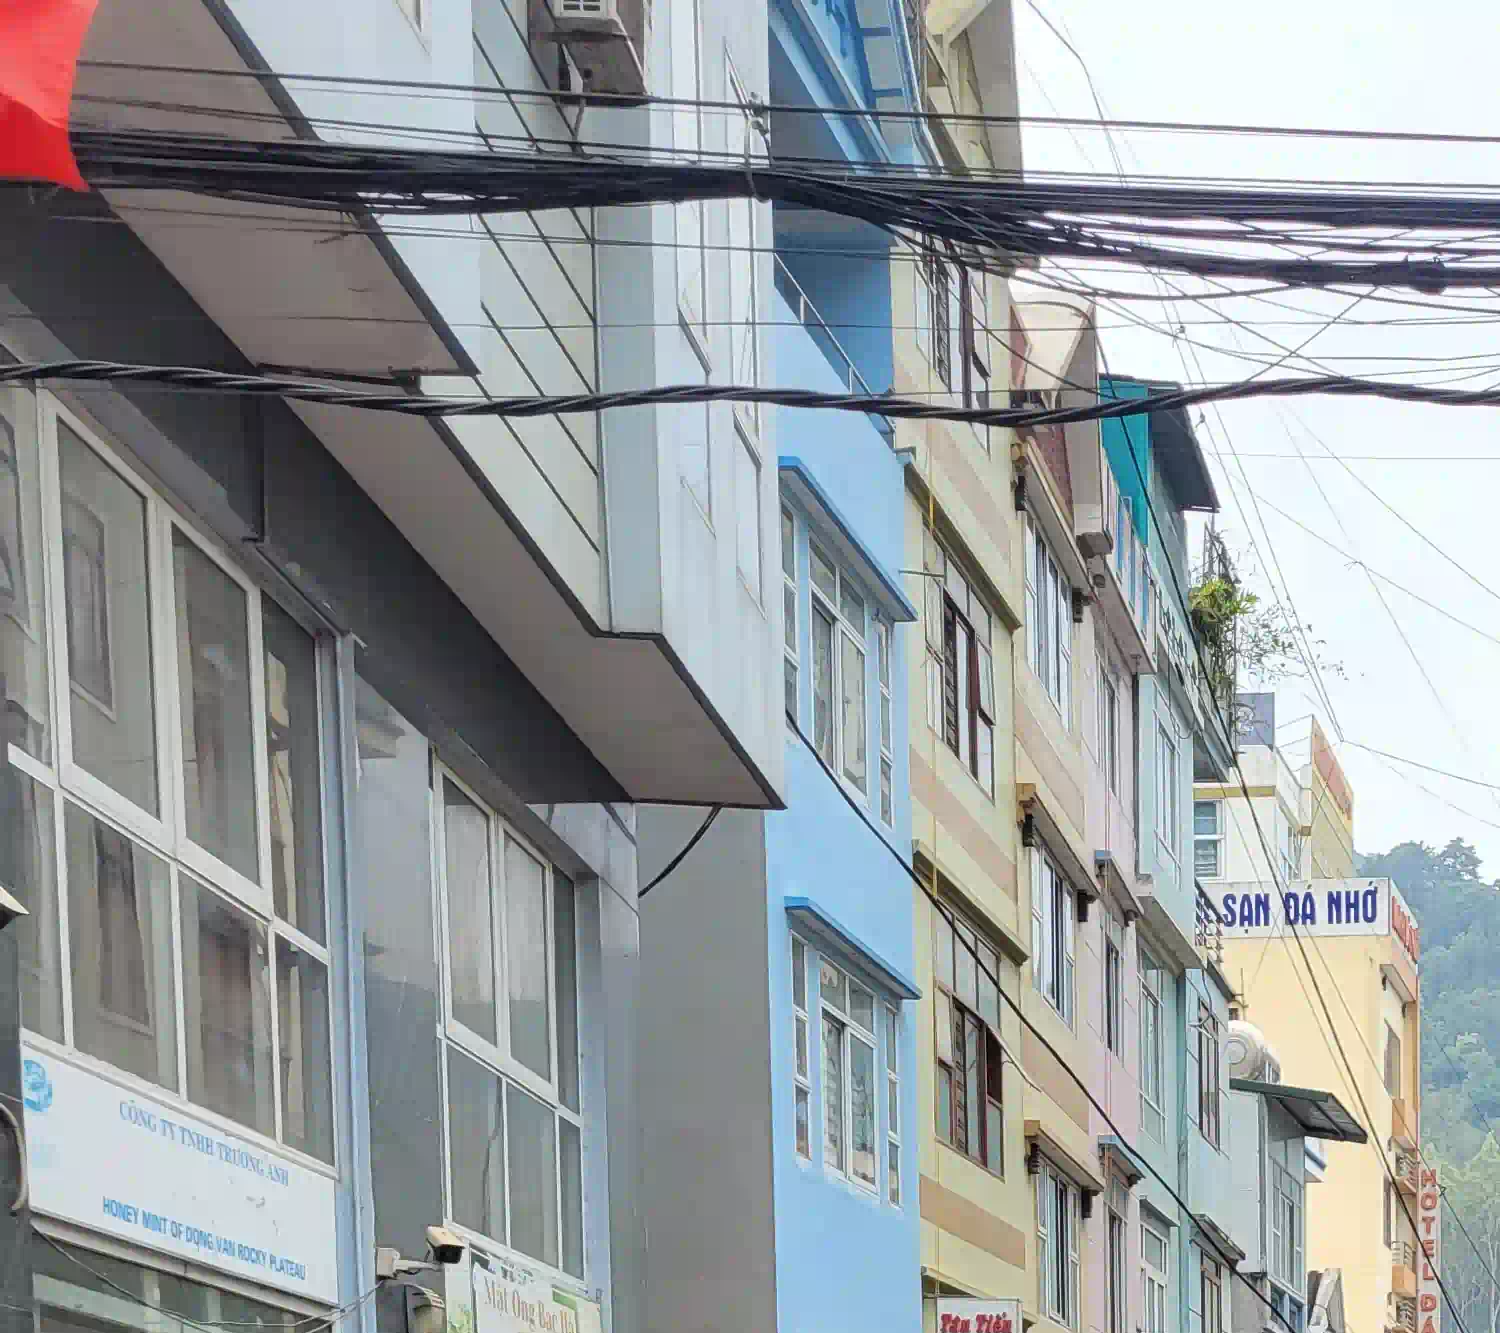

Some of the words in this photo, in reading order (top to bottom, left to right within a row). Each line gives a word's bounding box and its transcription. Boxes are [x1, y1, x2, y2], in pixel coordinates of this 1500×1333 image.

[1222, 893, 1270, 934] SẠN
[1284, 884, 1317, 926] ĐÁ
[120, 1100, 157, 1134] CÔNG
[160, 1119, 176, 1142] TY
[179, 1126, 213, 1156] TNHH
[102, 1195, 140, 1226] HONEY
[142, 1207, 169, 1234] MINT
[170, 1220, 183, 1240] OF
[216, 1237, 236, 1258] VAN
[237, 1243, 268, 1267] ROCKY
[269, 1254, 307, 1281] PLATEAU
[1420, 1168, 1438, 1282] HOTEL
